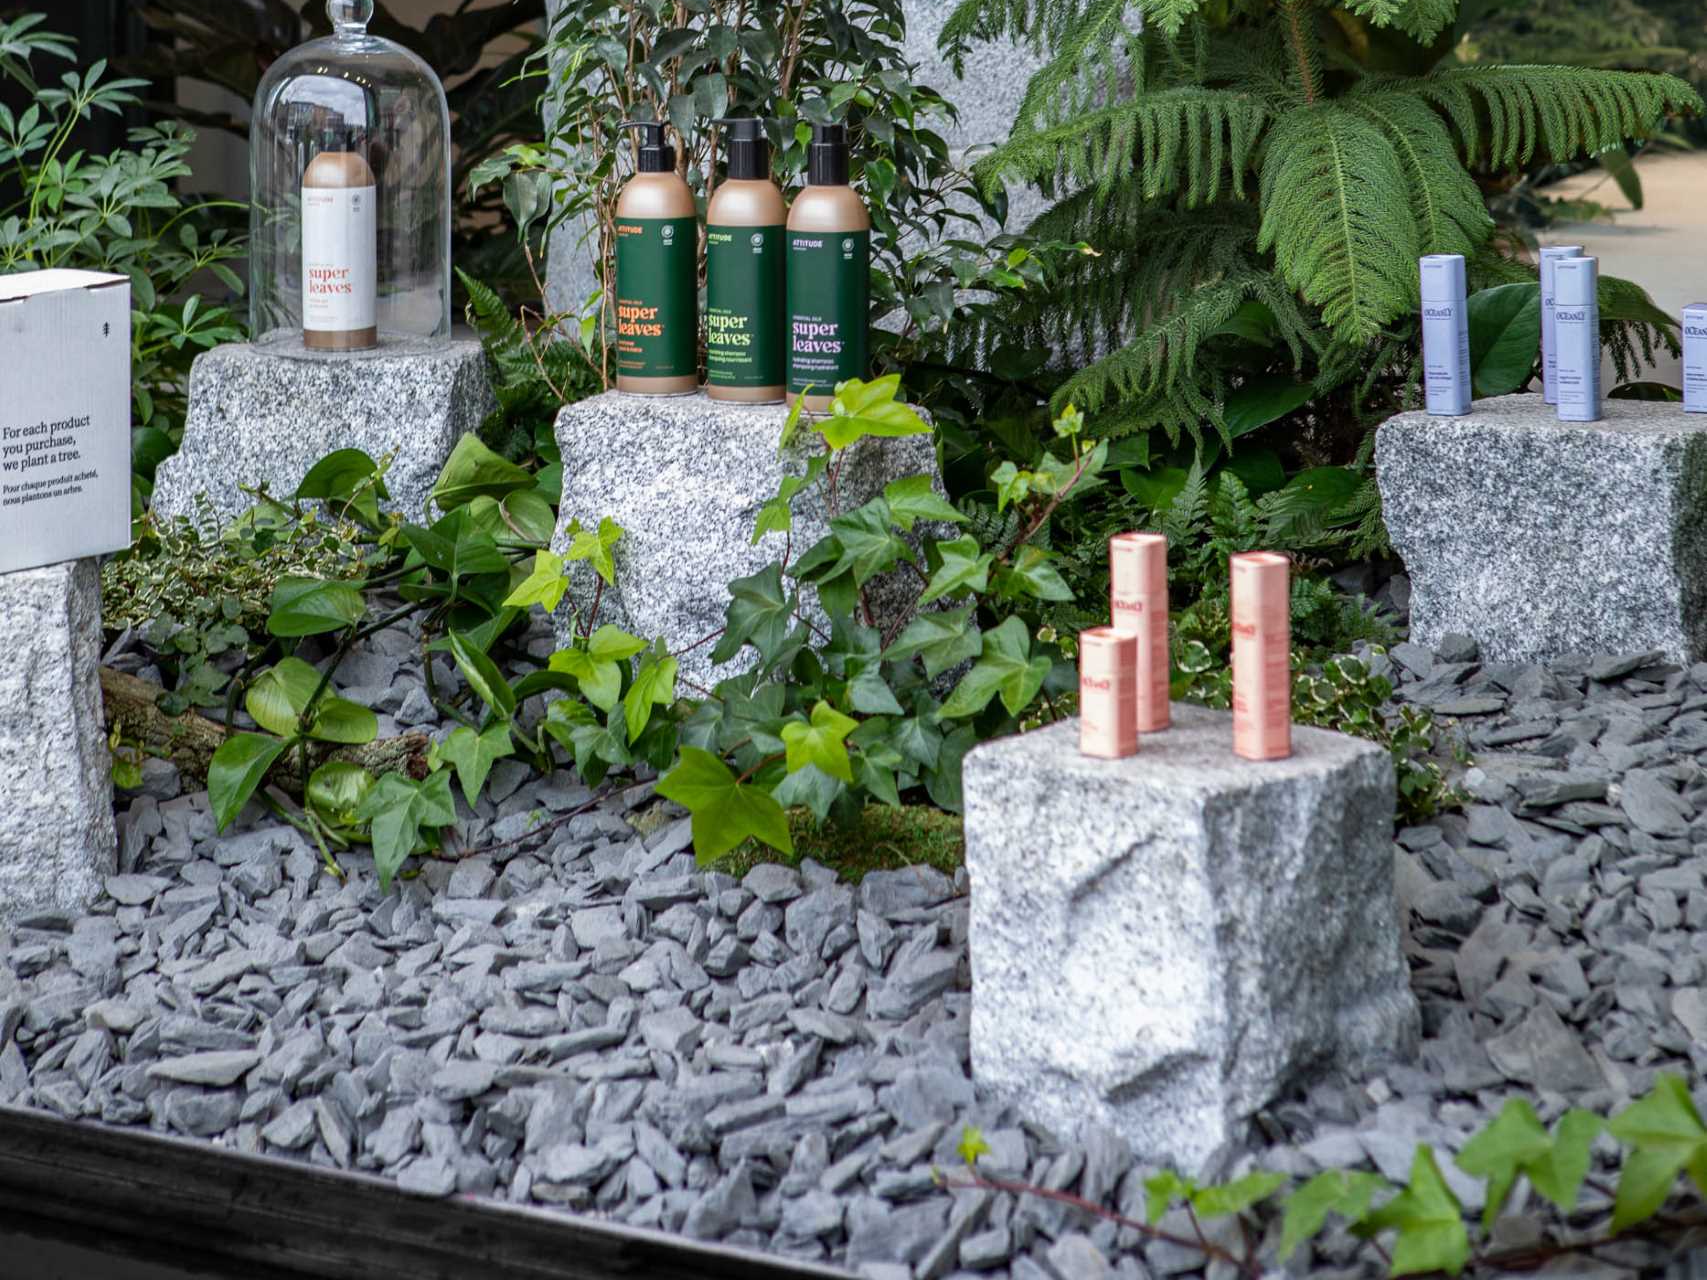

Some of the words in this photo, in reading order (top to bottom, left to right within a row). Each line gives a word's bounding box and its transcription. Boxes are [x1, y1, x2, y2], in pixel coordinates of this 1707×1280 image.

[309, 268, 350, 282] super
[309, 279, 352, 294] leaves
[618, 305, 658, 324] super
[708, 314, 748, 332] super
[618, 318, 662, 336] leaves
[792, 322, 838, 340] super
[708, 327, 751, 346] leaves
[792, 335, 842, 353] leaves
[3, 426, 21, 440] For
[23, 421, 48, 437] each
[50, 415, 90, 435] product
[3, 444, 23, 458] you
[25, 436, 76, 455] purchase,
[3, 461, 19, 472] we
[21, 454, 49, 472] plant
[50, 454, 57, 464] a
[58, 450, 80, 462] tree.
[3, 484, 19, 494] Pour
[21, 479, 47, 492] chaque
[47, 474, 73, 489] produit
[3, 497, 21, 506] nous
[21, 491, 52, 505] plantons
